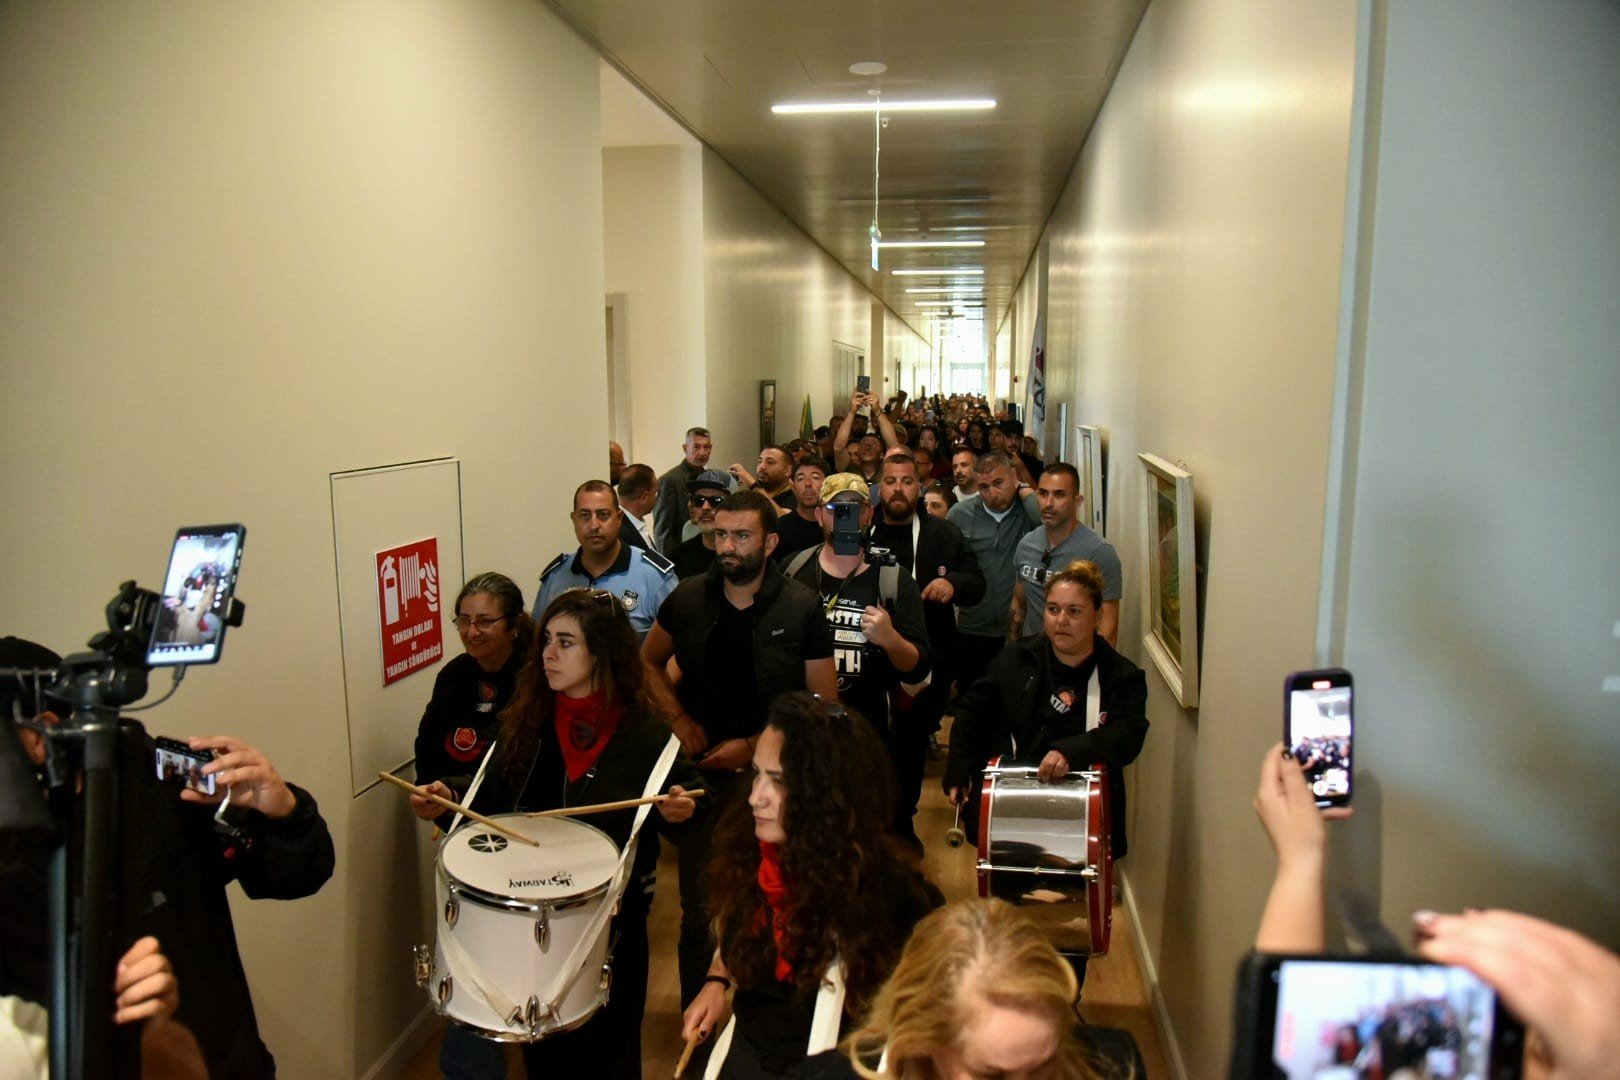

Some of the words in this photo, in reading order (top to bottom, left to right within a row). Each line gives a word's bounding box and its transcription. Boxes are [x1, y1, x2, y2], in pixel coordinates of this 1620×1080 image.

[392, 627, 413, 647] YANGIN
[413, 618, 434, 638] DOLABI
[386, 659, 408, 679] YANGIN
[408, 642, 441, 669] SÖNDÜRÜCÜ
